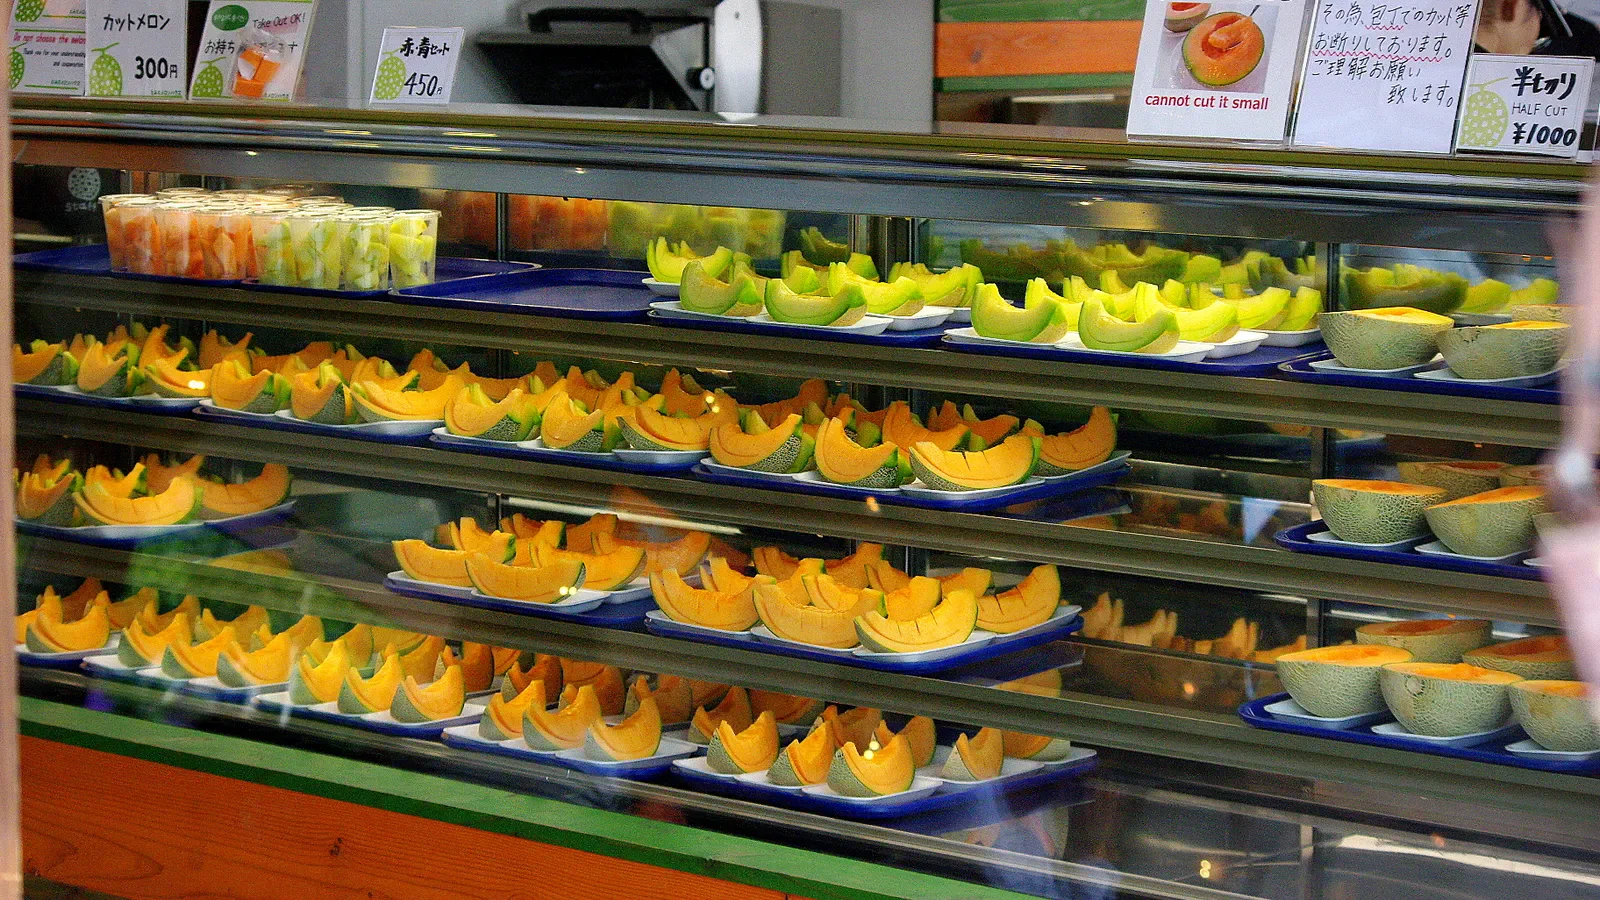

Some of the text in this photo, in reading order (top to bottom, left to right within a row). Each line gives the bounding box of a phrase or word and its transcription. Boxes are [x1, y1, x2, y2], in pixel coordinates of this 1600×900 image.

[103, 13, 170, 31] カットメロン
[253, 19, 271, 29] Take
[273, 16, 287, 27] Out
[1312, 57, 1421, 81] ご理解お願い
[1387, 80, 1454, 107] 致します。
[1511, 66, 1577, 100] 半切り
[1145, 95, 1269, 110] cannot cut it small
[1511, 102, 1568, 116] HALF CUT
[1512, 122, 1577, 146] ¥1000
